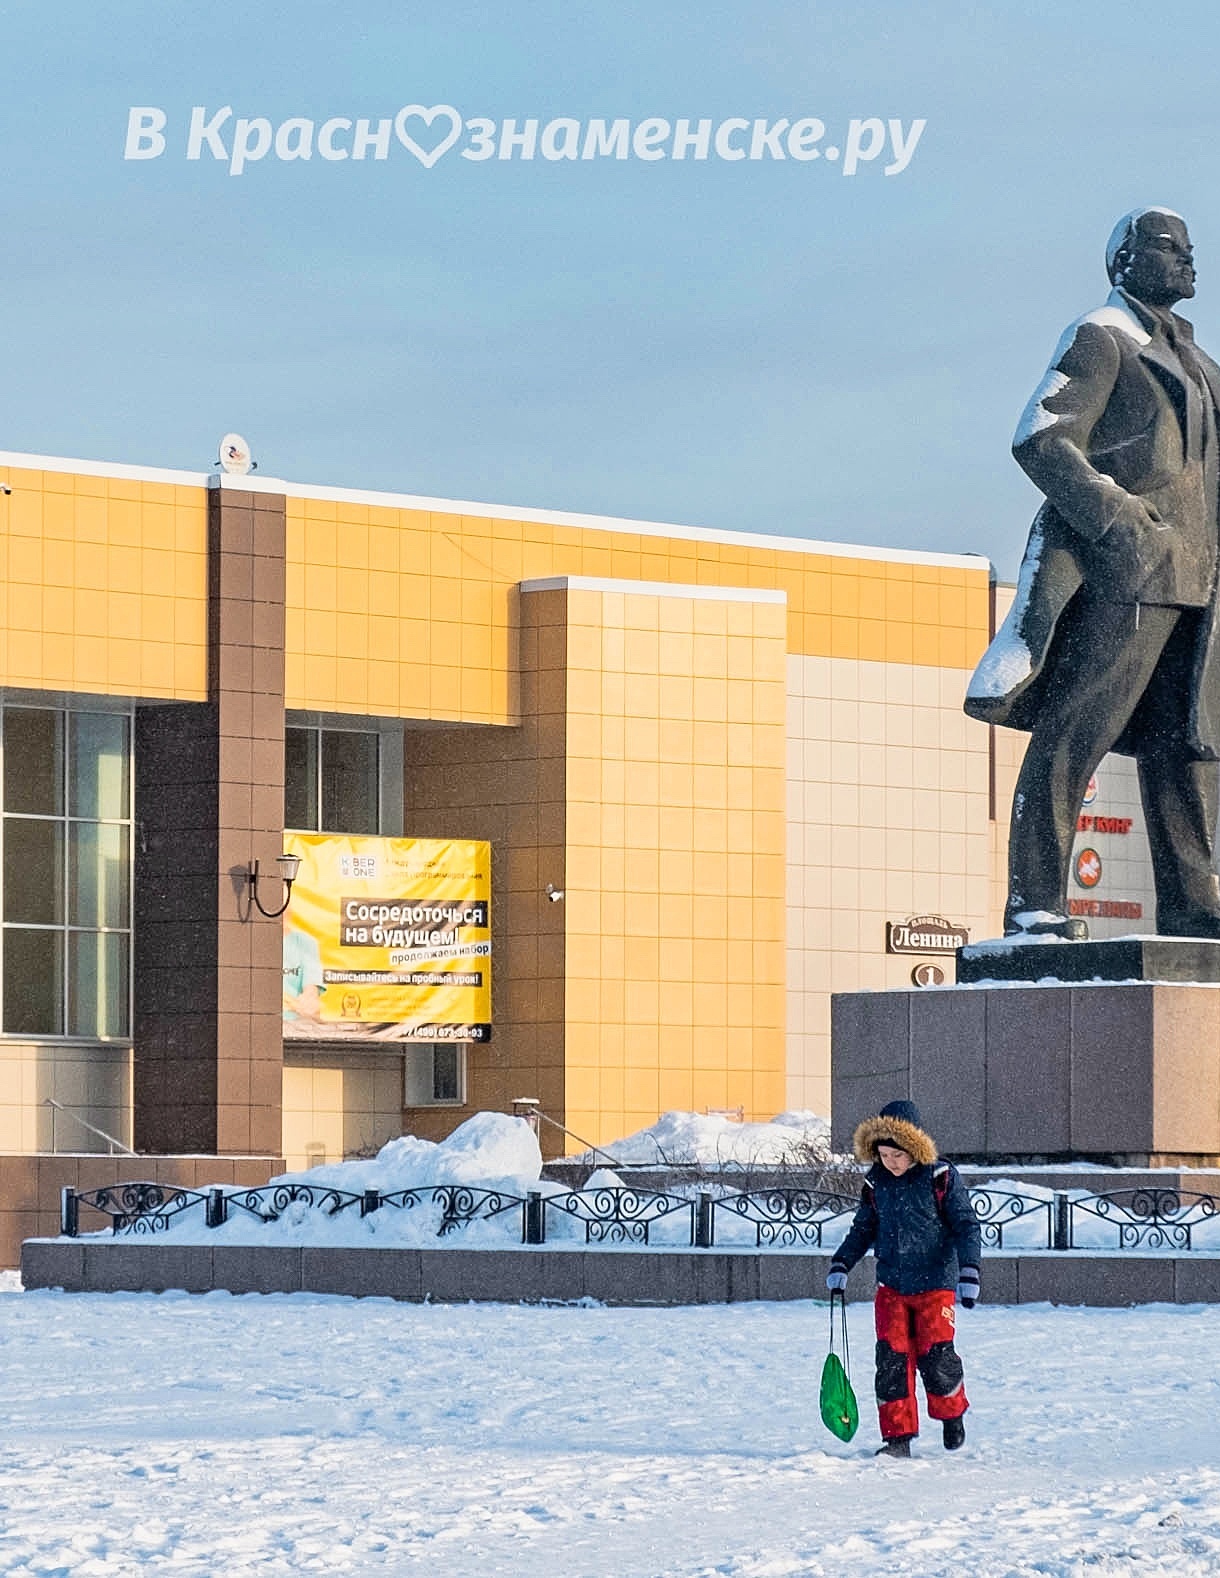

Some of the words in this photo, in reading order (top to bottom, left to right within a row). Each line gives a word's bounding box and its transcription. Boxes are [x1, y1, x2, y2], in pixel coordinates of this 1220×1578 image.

[1095, 816, 1133, 834] КИНГ
[353, 867, 375, 877] ONE
[345, 901, 483, 925] Сосредоточься
[345, 927, 368, 943] на
[372, 925, 459, 947] будущем!
[895, 927, 963, 948] Ленина
[391, 948, 458, 964] продолжаем
[459, 943, 489, 956] набор
[325, 970, 398, 983] Записывайтесь
[400, 973, 411, 983] на
[412, 972, 453, 985] пробный
[454, 973, 479, 986] урок!
[925, 966, 936, 985] 1
